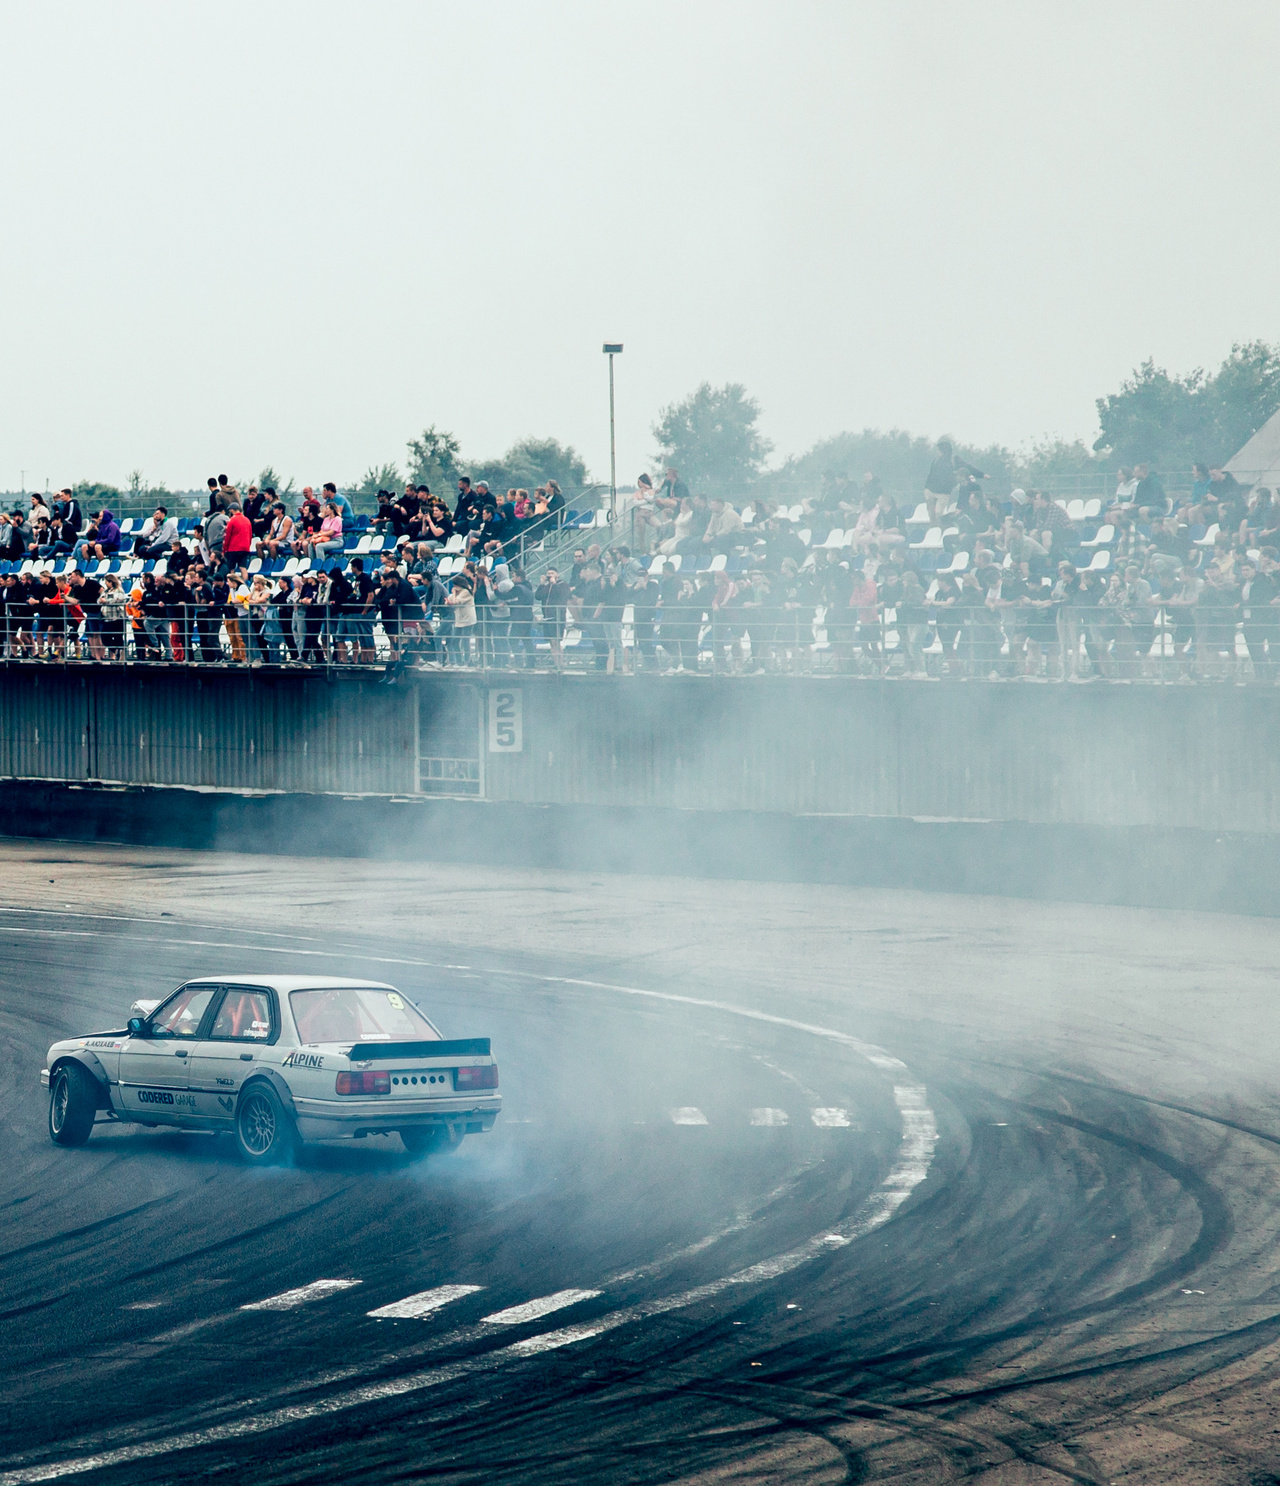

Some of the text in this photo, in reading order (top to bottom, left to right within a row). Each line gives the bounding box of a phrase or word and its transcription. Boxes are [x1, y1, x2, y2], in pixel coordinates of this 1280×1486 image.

[386, 993, 405, 1010] 9
[282, 1051, 325, 1068] ALPINE
[137, 1090, 174, 1105] CODERED
